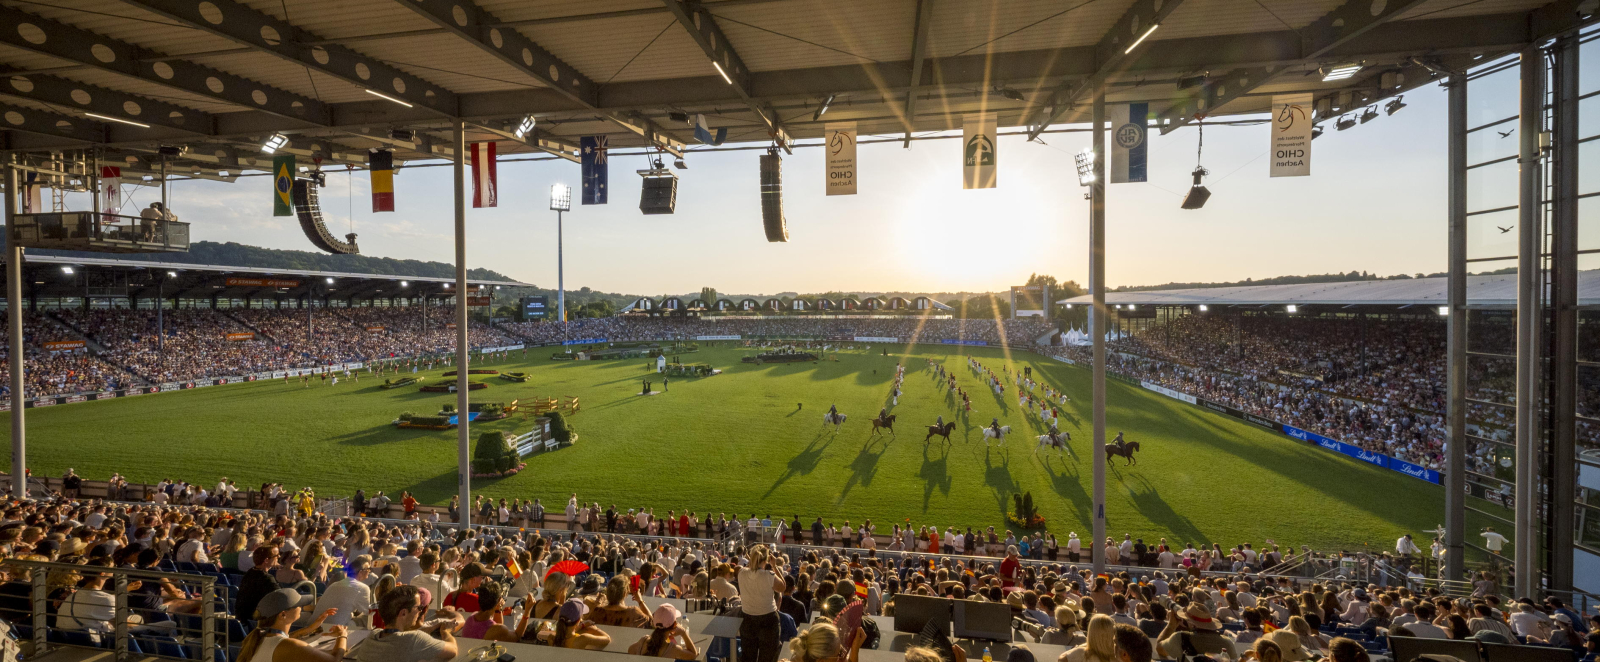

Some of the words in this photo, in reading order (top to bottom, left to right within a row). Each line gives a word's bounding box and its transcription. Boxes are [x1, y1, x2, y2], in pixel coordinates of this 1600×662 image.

[1320, 438, 1336, 450] Lindt
[1356, 450, 1376, 462] Lindt
[1401, 464, 1424, 477] Lindt
[1098, 504, 1104, 518] A
